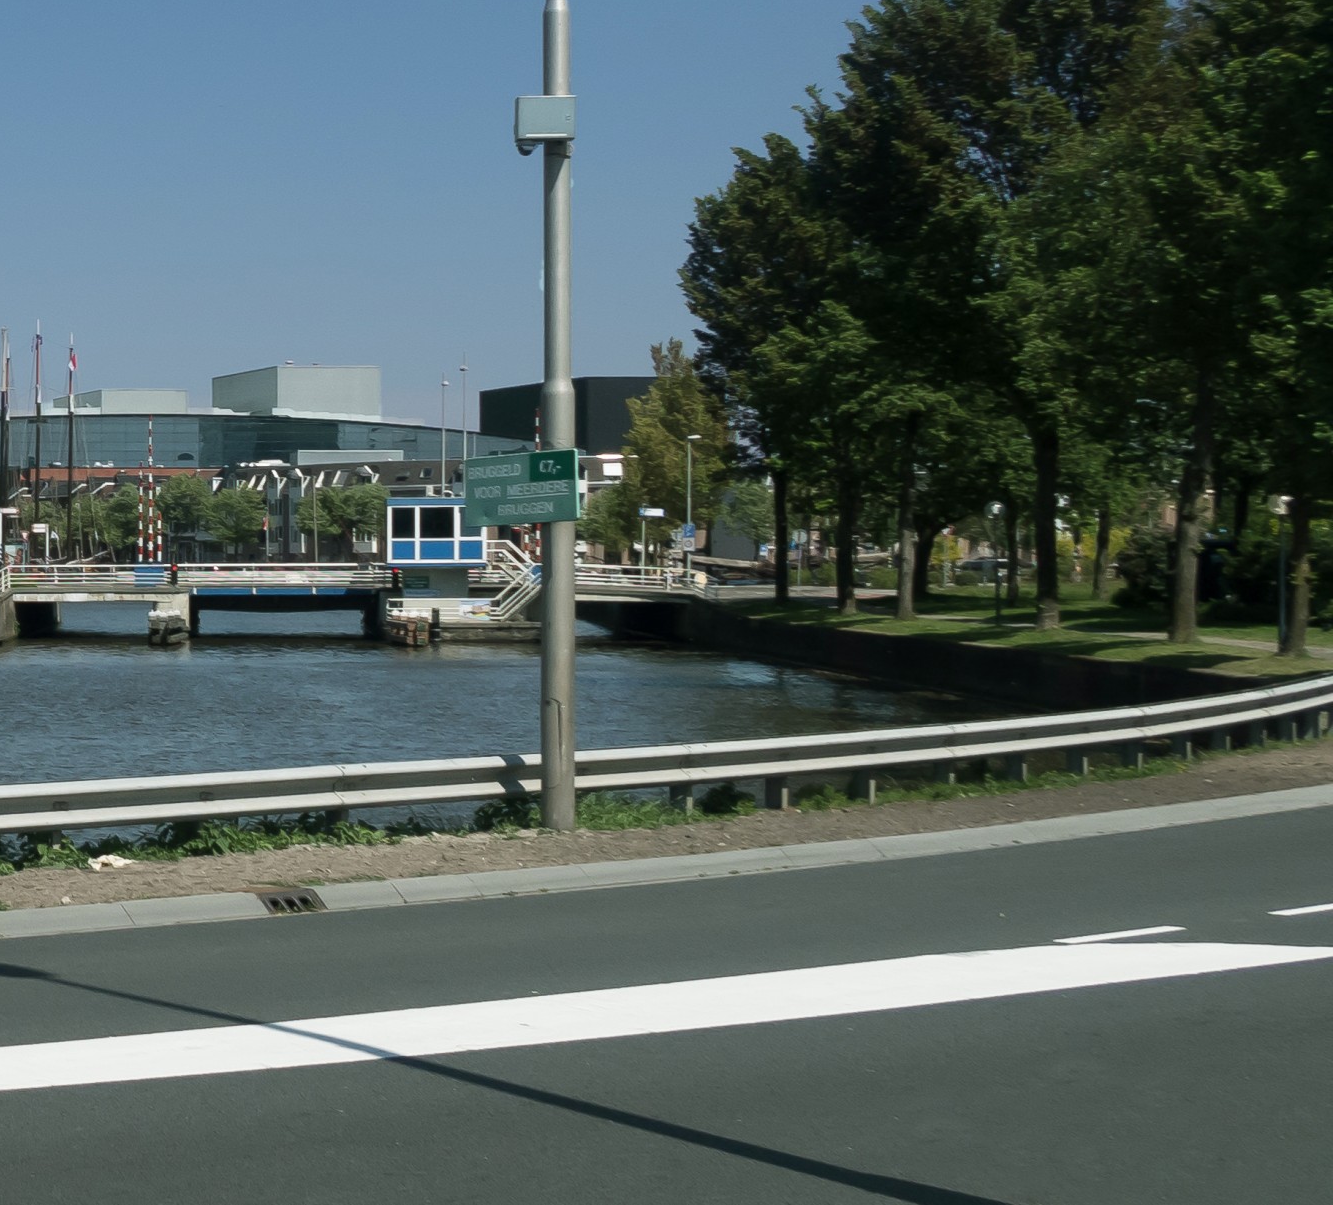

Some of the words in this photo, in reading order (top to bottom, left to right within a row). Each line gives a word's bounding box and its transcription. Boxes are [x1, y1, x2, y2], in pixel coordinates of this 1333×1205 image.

[468, 463, 521, 480] BRUGGELD
[474, 485, 501, 499] VOOR
[497, 501, 554, 516] BRUGGEN
